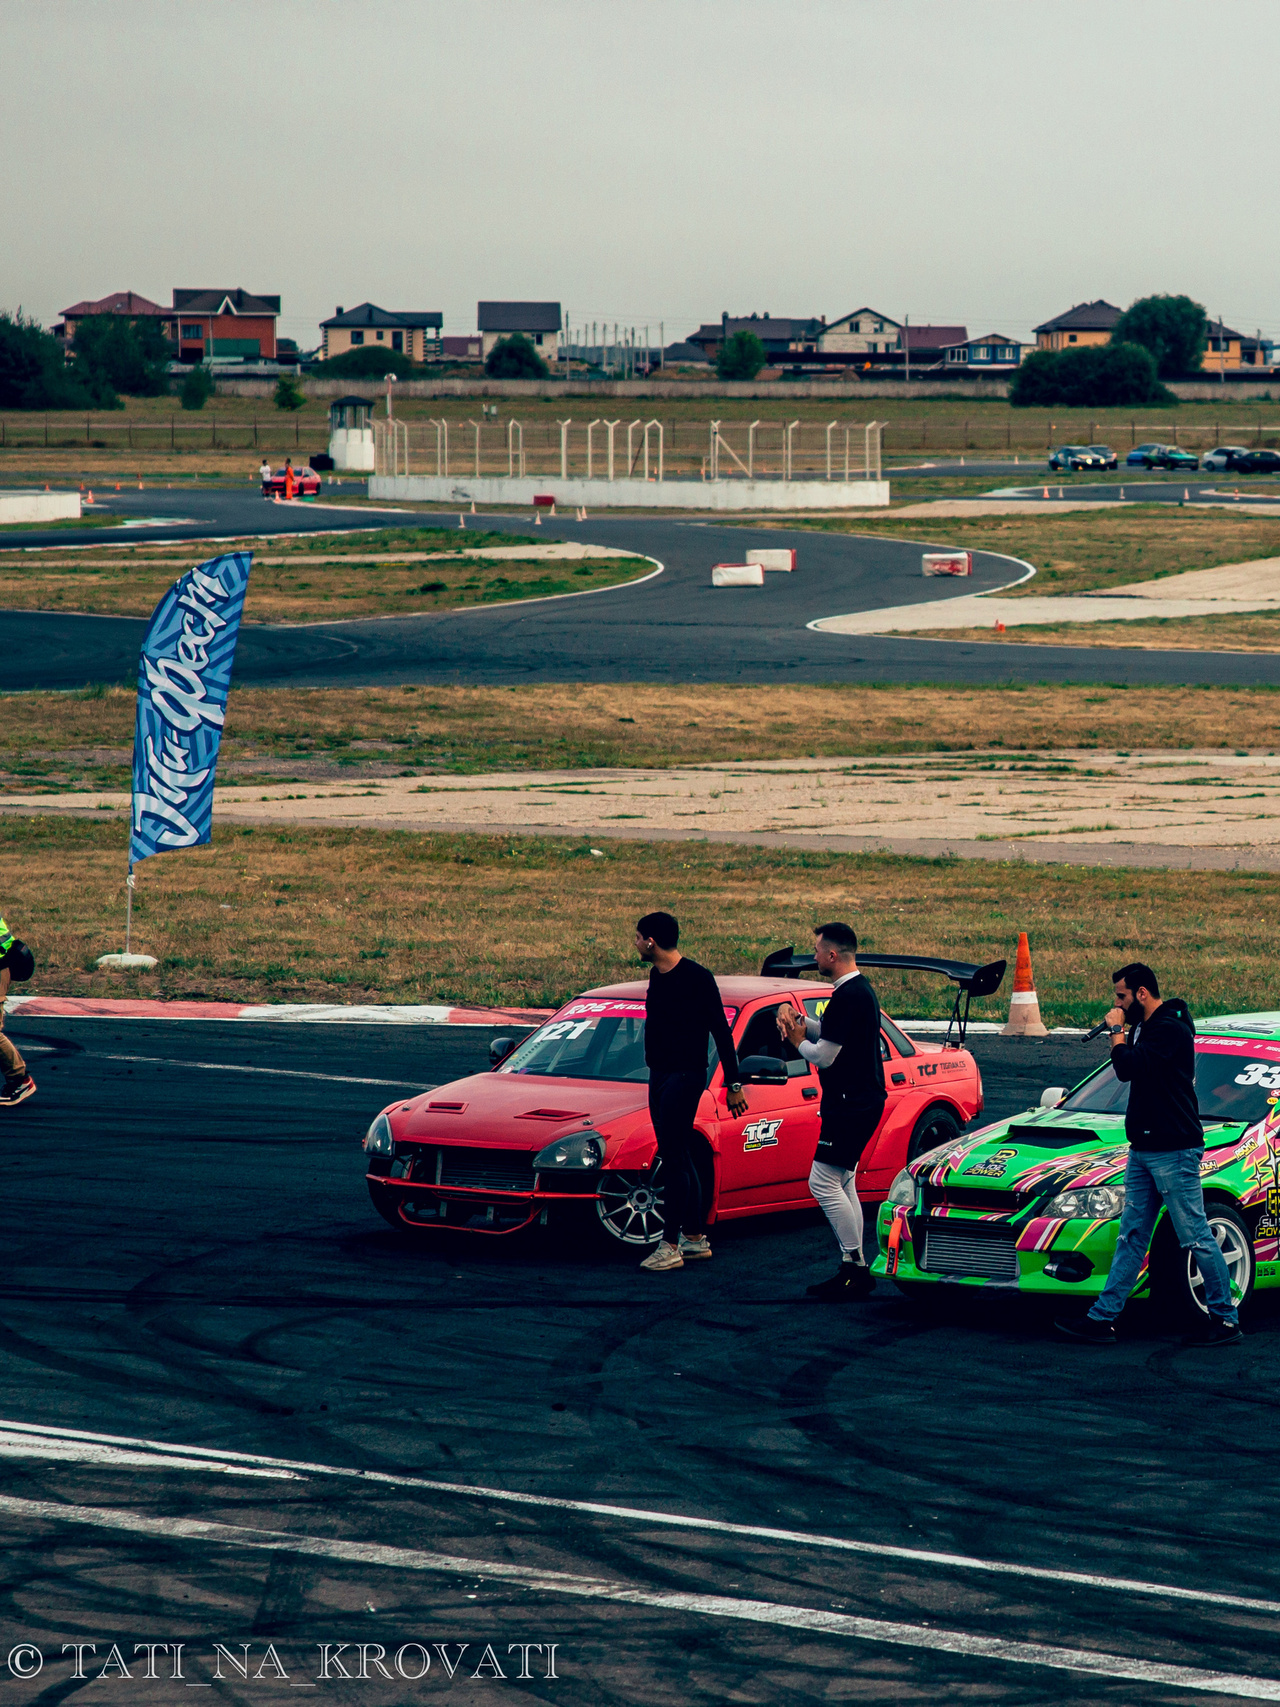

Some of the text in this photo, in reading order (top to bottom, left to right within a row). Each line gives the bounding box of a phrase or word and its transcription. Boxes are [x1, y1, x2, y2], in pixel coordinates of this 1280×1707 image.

[563, 1002, 612, 1016] RDS
[532, 1020, 593, 1044] 121
[917, 1063, 939, 1077] TCS
[745, 1121, 781, 1142] TCS
[964, 1167, 1004, 1178] POWER
[973, 1163, 1003, 1171] SLIDE
[1257, 1266, 1276, 1277] HKS
